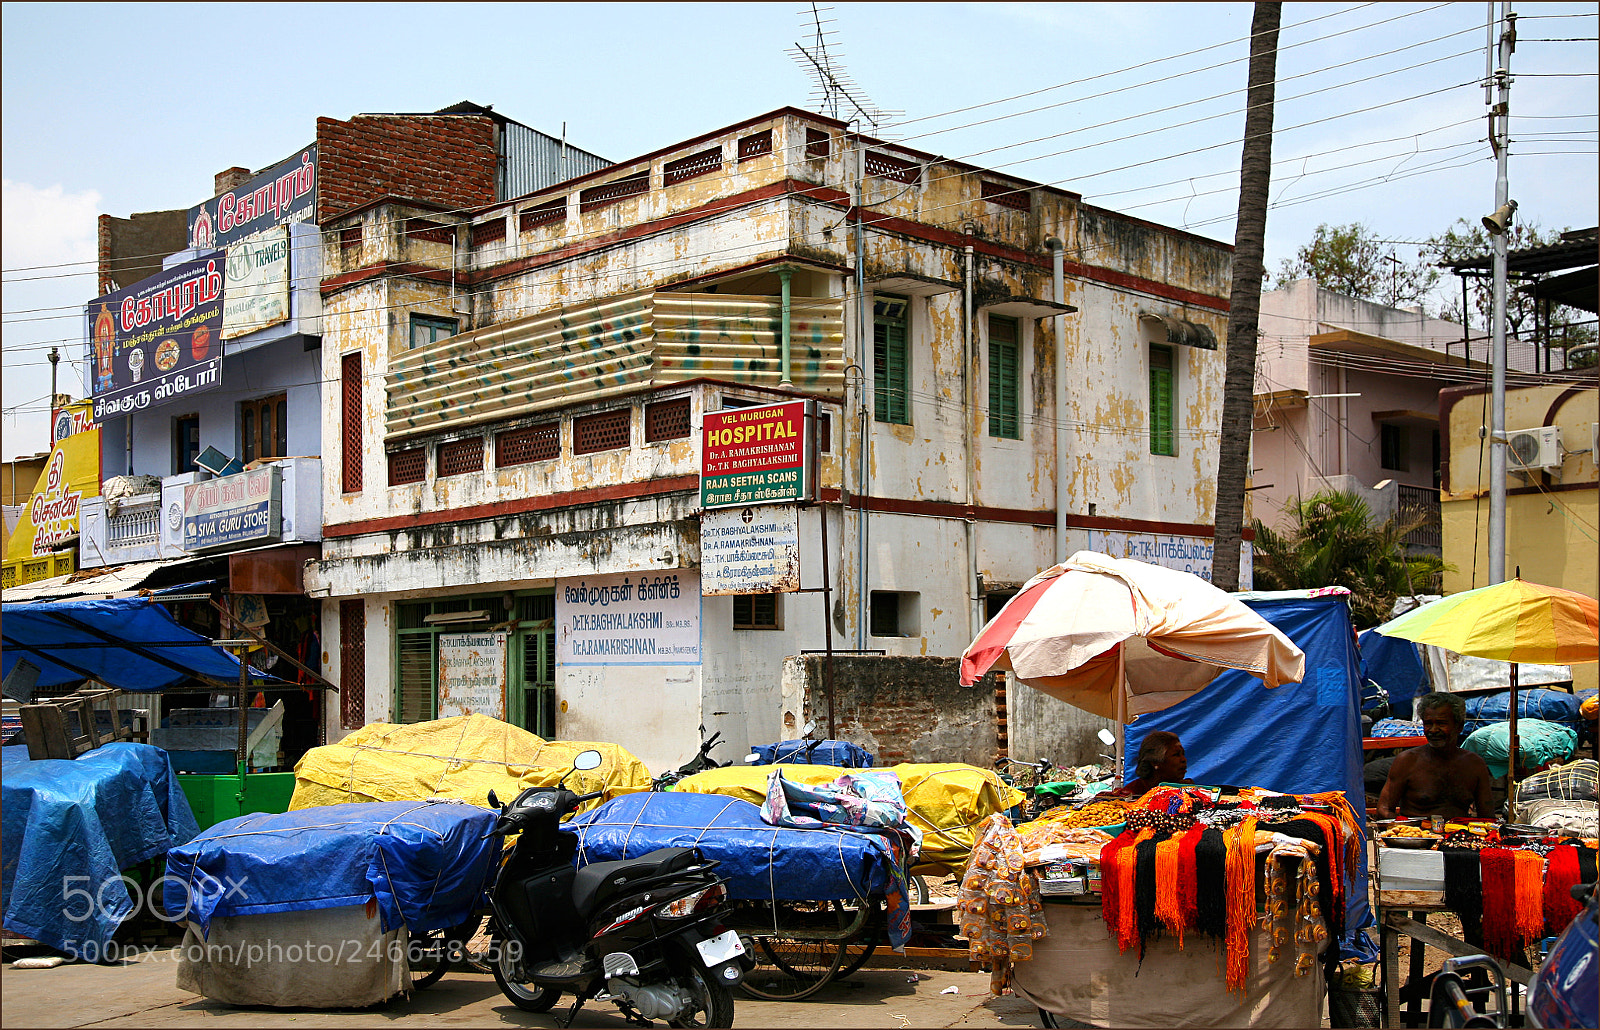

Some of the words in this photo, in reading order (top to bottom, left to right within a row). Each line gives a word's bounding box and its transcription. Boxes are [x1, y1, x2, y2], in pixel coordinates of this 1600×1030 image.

[218, 151, 314, 233] கோபுரம்
[255, 240, 286, 268] TRAVELS
[121, 260, 222, 332] கோபுரம்
[95, 391, 150, 418] சிவகுரு
[155, 361, 218, 400] ஸ்டோர்
[722, 415, 737, 424] VEL
[740, 408, 784, 422] MURUGAN
[708, 420, 797, 447] HOSPITAL
[729, 442, 795, 458] RAMAKRISHANAN
[732, 454, 798, 469] BAGHYALAKSHMI
[706, 478, 728, 489] RAJA
[730, 474, 765, 487] SEETHA
[767, 471, 797, 484] SCANS
[734, 489, 752, 502] சீதா
[754, 484, 797, 499] ஸ்கேன்ஸ்
[199, 522, 216, 537] SIVA
[219, 516, 241, 533] GURU
[244, 511, 268, 528] STORE
[565, 577, 633, 606] வேல்முருகன்
[637, 574, 680, 601] கிளினிக்
